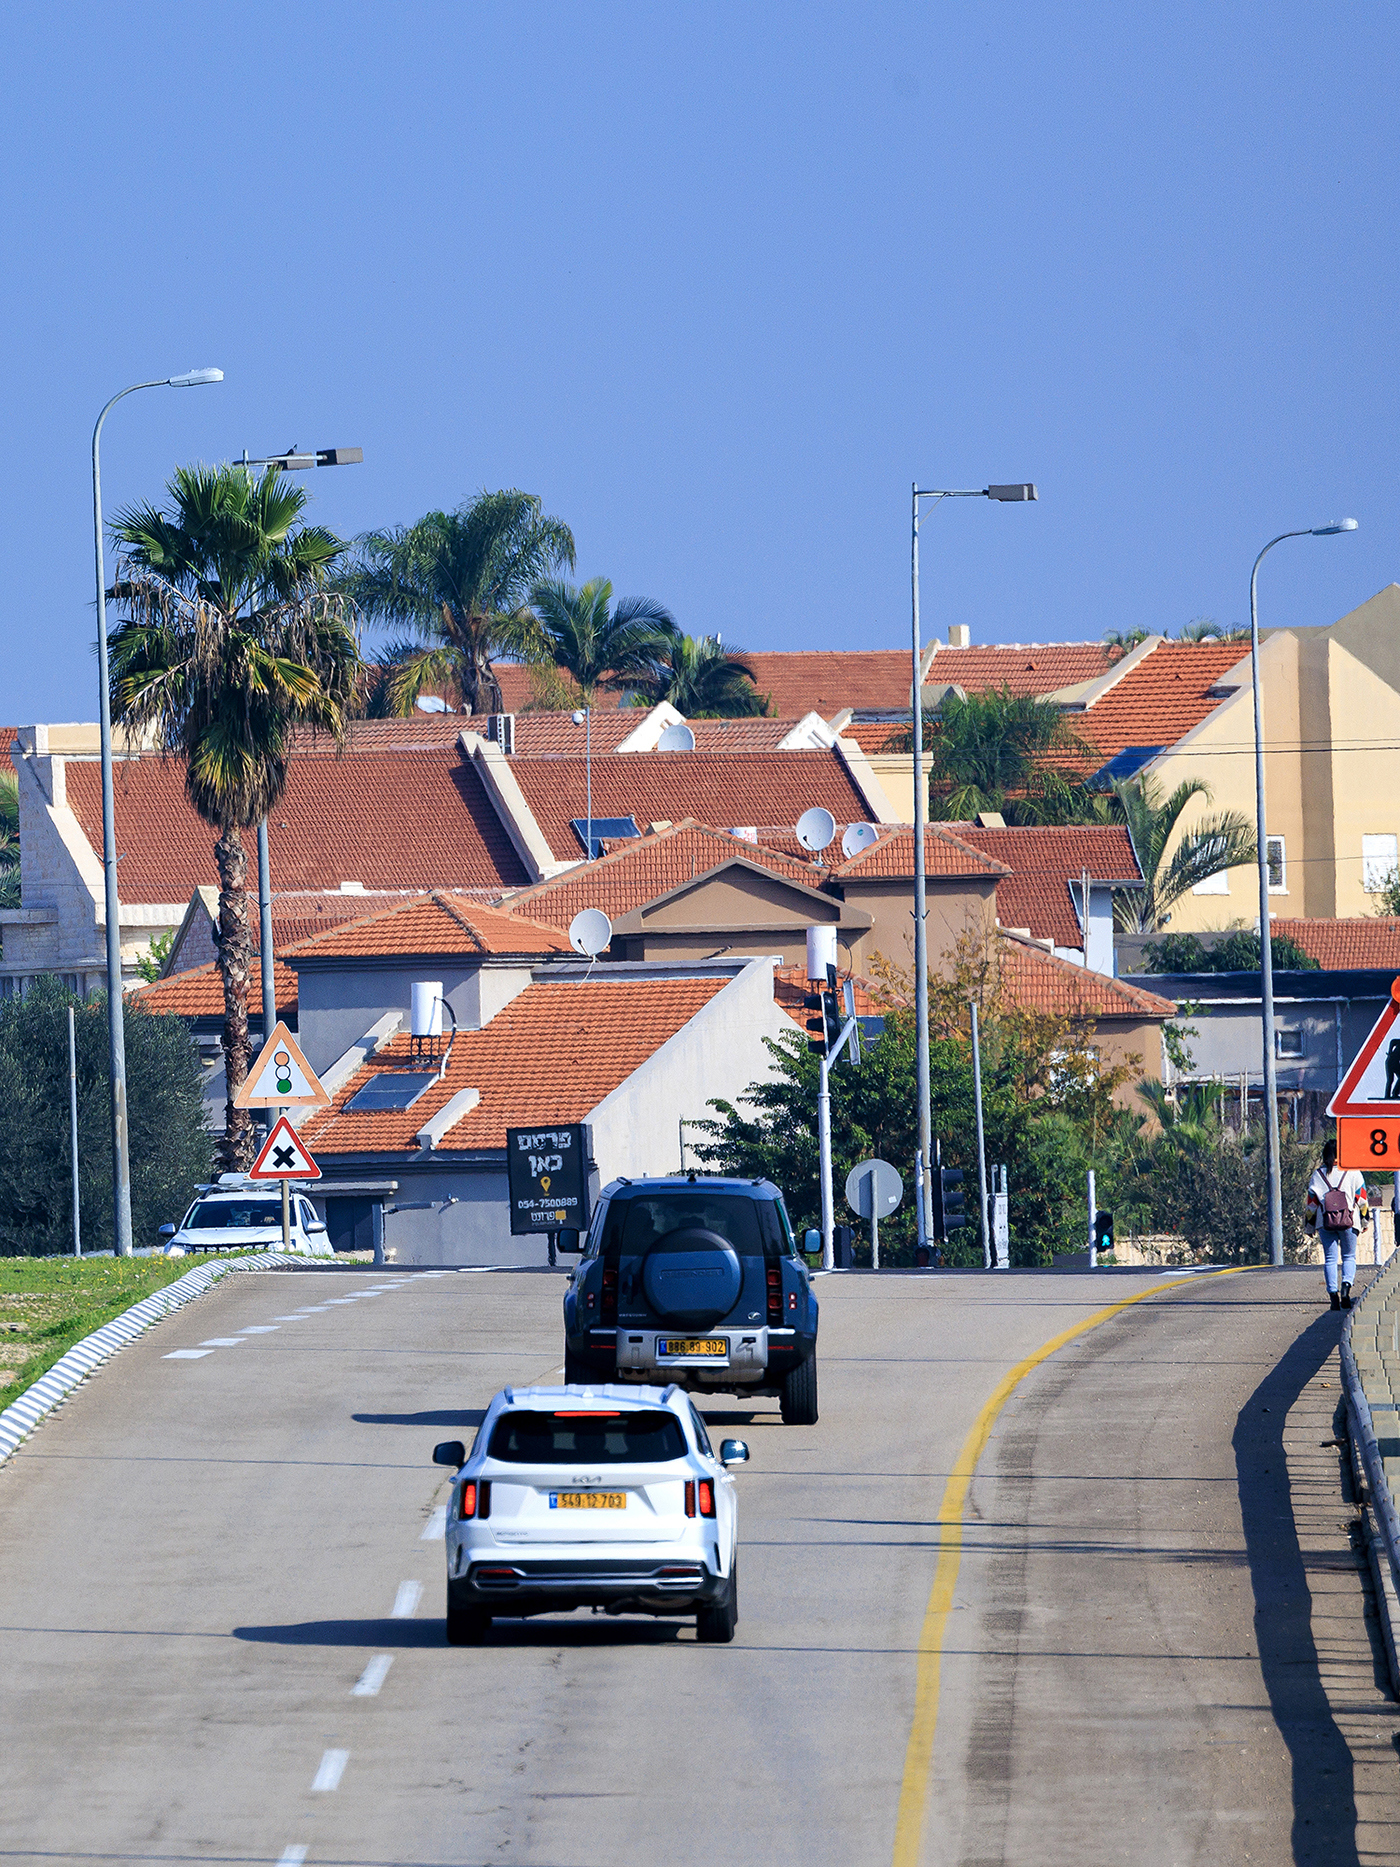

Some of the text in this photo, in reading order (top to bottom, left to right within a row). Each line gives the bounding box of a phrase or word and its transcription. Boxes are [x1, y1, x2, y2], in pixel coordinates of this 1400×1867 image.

[517, 1132, 571, 1150] פרסם
[1370, 1129, 1400, 1156] 8
[528, 1155, 562, 1177] כאן
[518, 1197, 578, 1208] 054-7500889
[531, 1211, 555, 1221] פרונט
